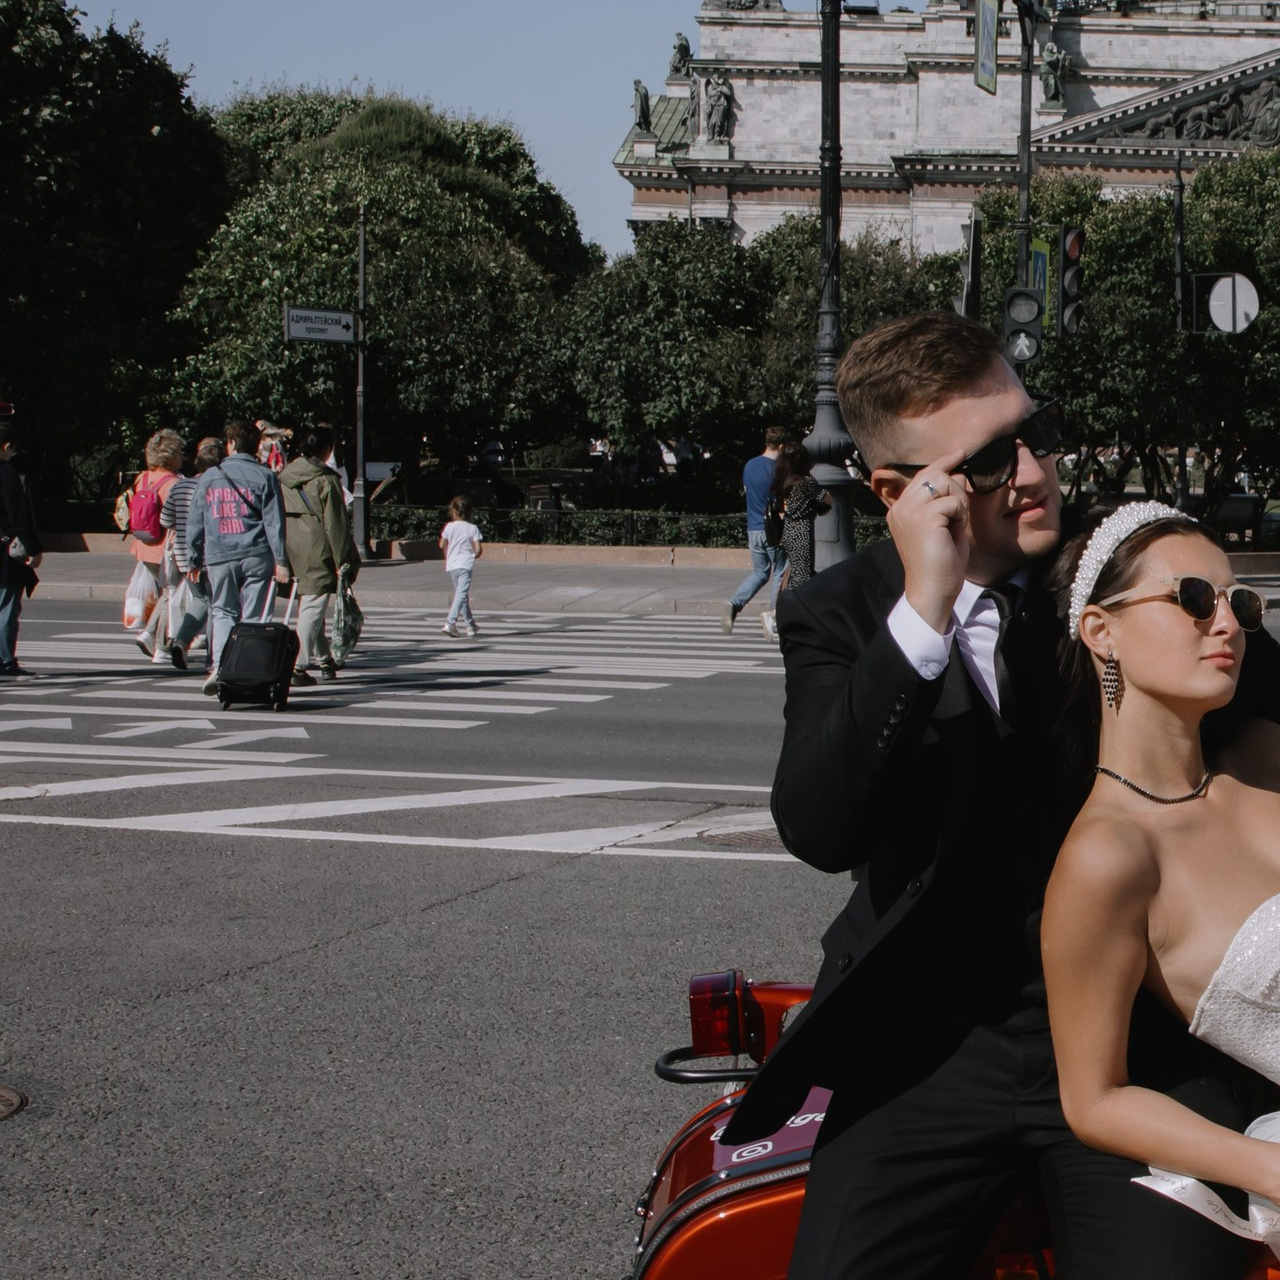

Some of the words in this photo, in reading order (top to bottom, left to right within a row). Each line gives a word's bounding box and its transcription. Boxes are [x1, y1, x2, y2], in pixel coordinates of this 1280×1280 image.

[291, 314, 342, 326] АДМИРАЛТЕЙСКИЙ
[305, 326, 328, 334] проспект
[211, 502, 238, 519] LIKE
